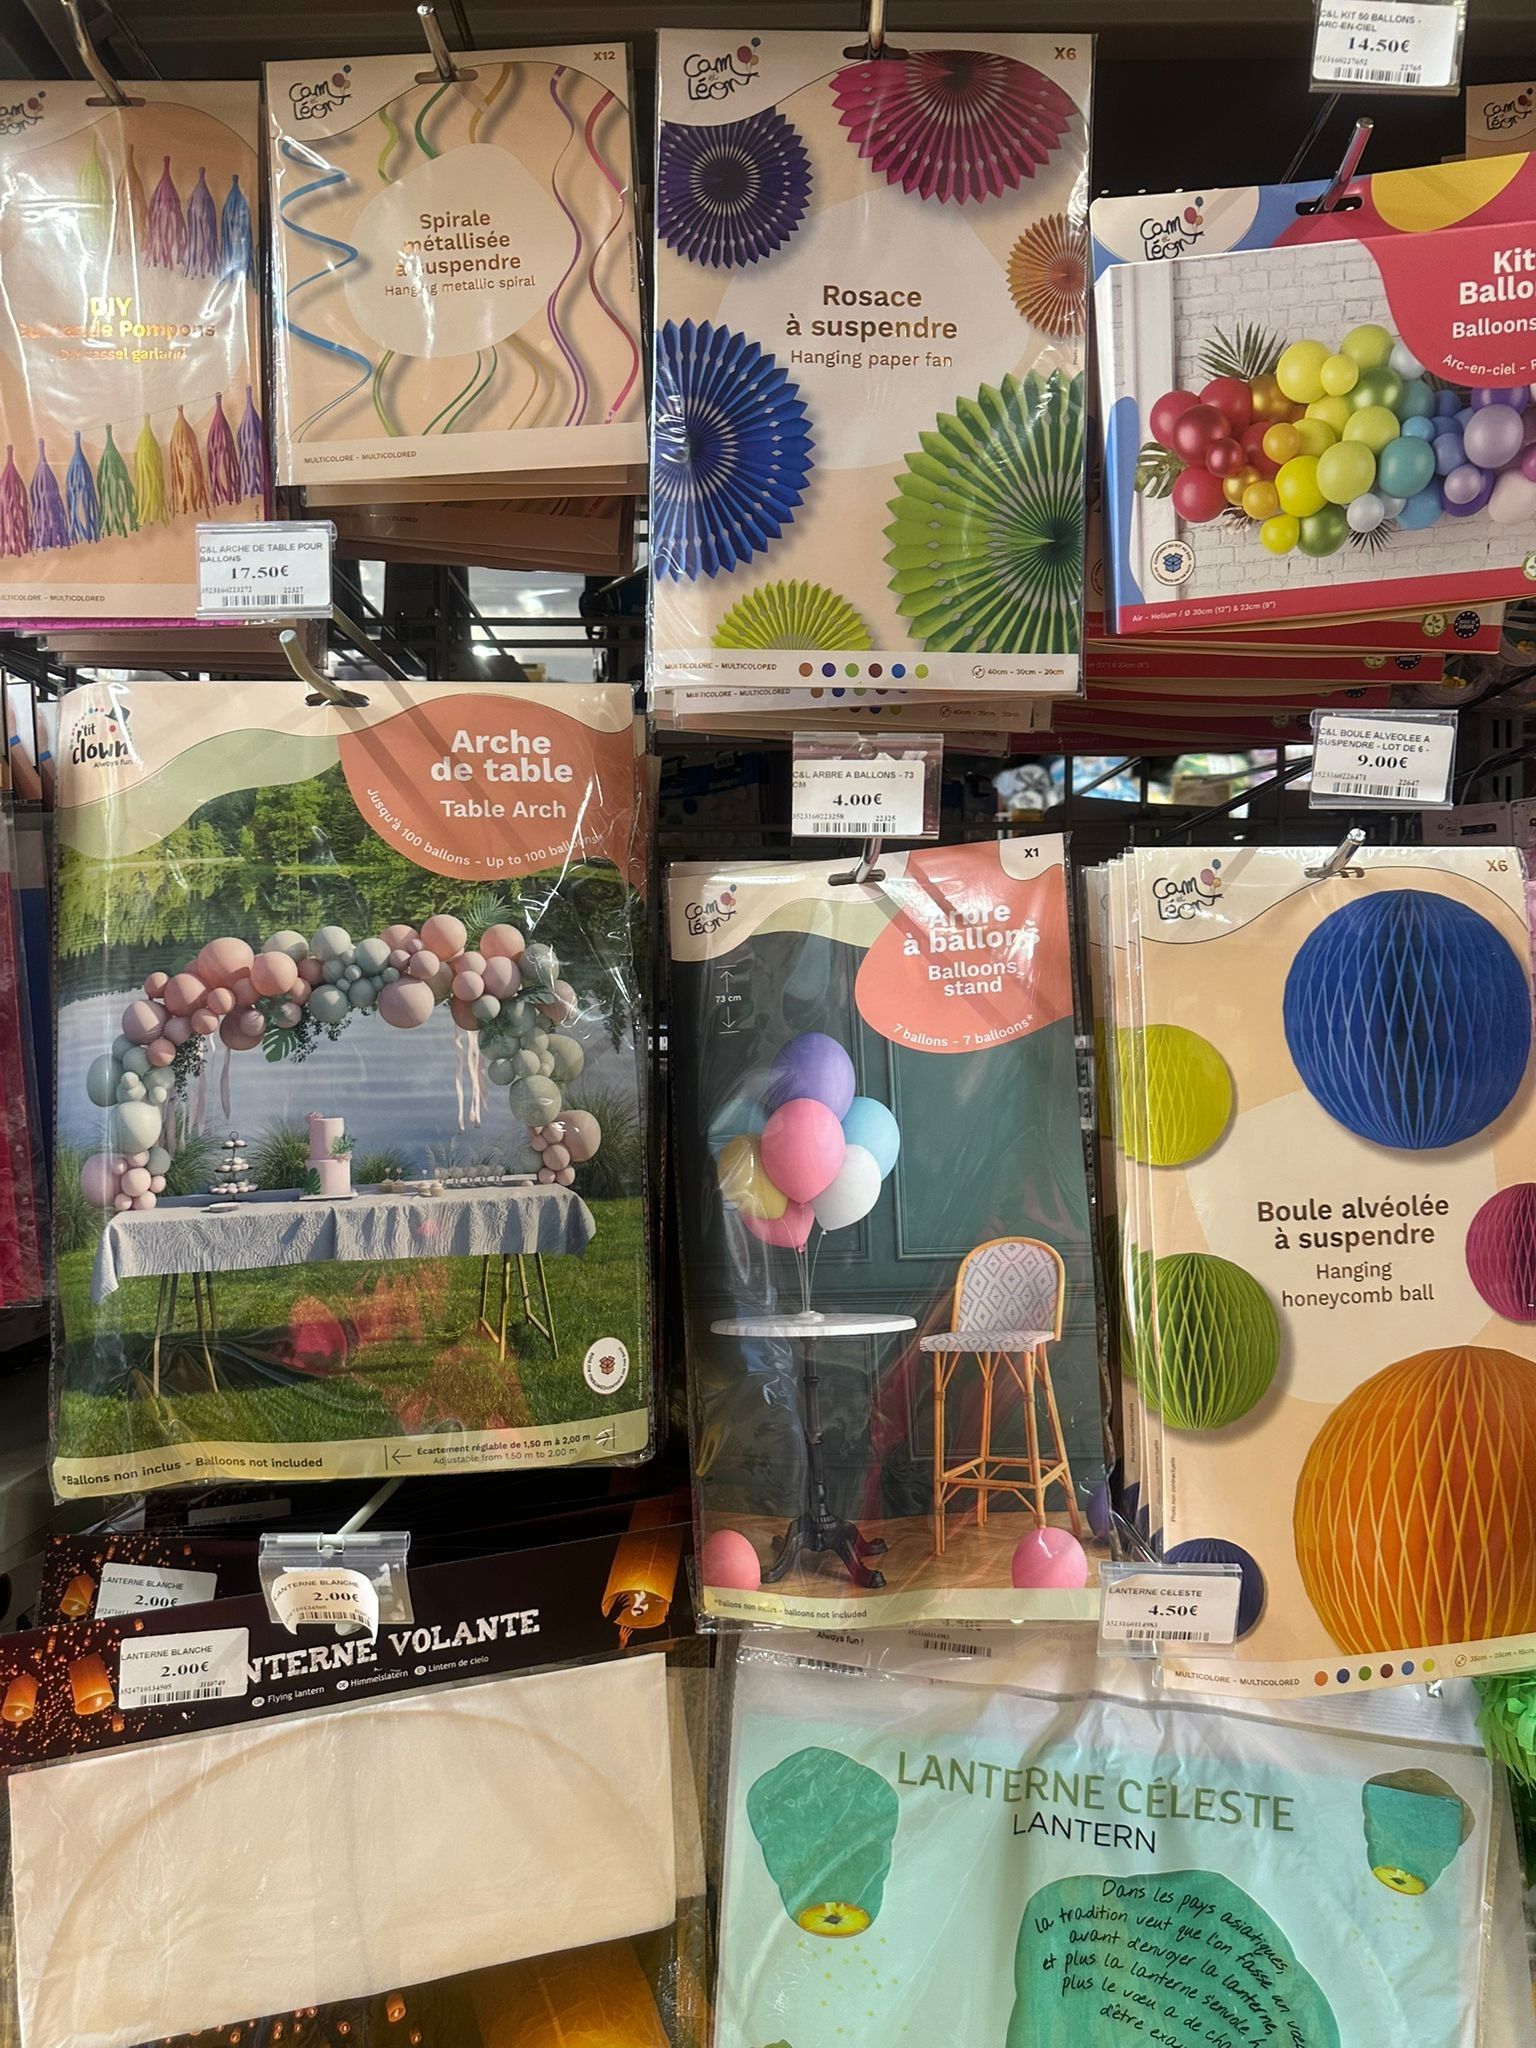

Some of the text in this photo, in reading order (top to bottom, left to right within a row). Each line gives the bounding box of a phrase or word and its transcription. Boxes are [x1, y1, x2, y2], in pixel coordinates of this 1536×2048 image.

[1341, 10, 1415, 24] KIT BALLONS
[1054, 46, 1077, 60] X6
[1349, 37, 1410, 53] 14.50€
[593, 51, 616, 62] X12
[419, 209, 491, 233] Spirale
[403, 231, 511, 253] métallisée
[1494, 247, 1536, 274] Kit
[442, 275, 536, 292] metallic spiral
[823, 286, 922, 307] Rosace
[786, 313, 958, 342] à suspendre
[790, 350, 953, 370] Hanging paper fan
[1442, 353, 1516, 376] Arc-en-ciel
[304, 450, 417, 464] MULTICOLORE MULTICOLORED
[220, 542, 323, 553] ARCHE DE TABLE POUR
[200, 555, 241, 563] BALLONS
[232, 565, 289, 579] 17.50€
[451, 728, 551, 754] Arche
[1318, 738, 1416, 752] SUSPENDRE LOT DE
[1340, 729, 1431, 743] BOULE ALVEOLEE A
[72, 738, 129, 765] clown
[431, 756, 573, 783] de table
[1358, 754, 1408, 769] 9.00€
[812, 771, 843, 779] ARBRE
[846, 771, 852, 779] A
[854, 771, 896, 779] BALLONS
[904, 771, 914, 779] 73
[440, 799, 566, 818] Table Arch
[833, 793, 882, 806] 4.00€
[401, 828, 423, 847] 100
[424, 841, 471, 866] ballons
[486, 856, 504, 868] Up
[508, 854, 522, 865] to
[525, 849, 547, 863] 100
[1024, 847, 1040, 859] X1
[1486, 859, 1509, 873] X6
[903, 933, 920, 956] à
[928, 961, 1017, 981] Balloons
[944, 976, 1002, 997] stand
[715, 993, 742, 1003] 73 cm
[893, 1023, 903, 1033] 7
[902, 1028, 949, 1047] ballons
[963, 1035, 971, 1045] 7
[1256, 1194, 1450, 1223] Boule alvéolée
[1274, 1224, 1436, 1253] à suspendre
[1316, 1261, 1393, 1282] Hanging
[1281, 1284, 1435, 1310] honeycomb ball
[417, 1445, 470, 1457] Écartement
[471, 1441, 508, 1453] réglable
[510, 1440, 522, 1449] de
[554, 1436, 561, 1446] à
[582, 1434, 591, 1442] m
[433, 1455, 479, 1466] Adjustable
[481, 1453, 503, 1463] from
[536, 1450, 546, 1459] to
[114, 1470, 139, 1481] non
[142, 1461, 182, 1476] inclus
[195, 1457, 246, 1467] Balloons
[249, 1458, 268, 1468] not
[271, 1457, 323, 1468] included
[146, 1580, 184, 1590] BLANCHE
[1109, 1587, 1202, 1597] LANTERNE CELESTE
[313, 1592, 360, 1602] 2.00€
[784, 1608, 814, 1618] balloons
[816, 1611, 830, 1619] not
[831, 1610, 867, 1619] included
[1148, 1604, 1198, 1617] 4.50€
[388, 1609, 540, 1656] VOLANTE
[816, 1631, 859, 1645] Always fun
[121, 1645, 213, 1661] LANTERNE BLANCHE
[161, 1661, 209, 1677] 2.00€
[428, 1655, 489, 1673] Lintern de cielo
[1175, 1670, 1300, 1687] MULTICOLORE MULTICOLORED
[268, 1685, 325, 1704] Flying lantern
[898, 1751, 1294, 1832] LANTERNE CÉLESTE
[1013, 1811, 1156, 1853] LANTERN
[1102, 1879, 1145, 1900] Dans
[1154, 1886, 1174, 1904] les
[1177, 1893, 1217, 1919] pays
[1035, 1905, 1290, 2013] la tradition veut que l'on fasse un
[1069, 1929, 1219, 1978] avant d'envoyer la
[1042, 1952, 1251, 2035] et plus la lanterne s'envole
[1061, 1975, 1093, 1997] plus
[1101, 1976, 1116, 1993] le
[1163, 2005, 1179, 2018] a
[1182, 2017, 1201, 2033] de
[1100, 2003, 1145, 2031] d'être
